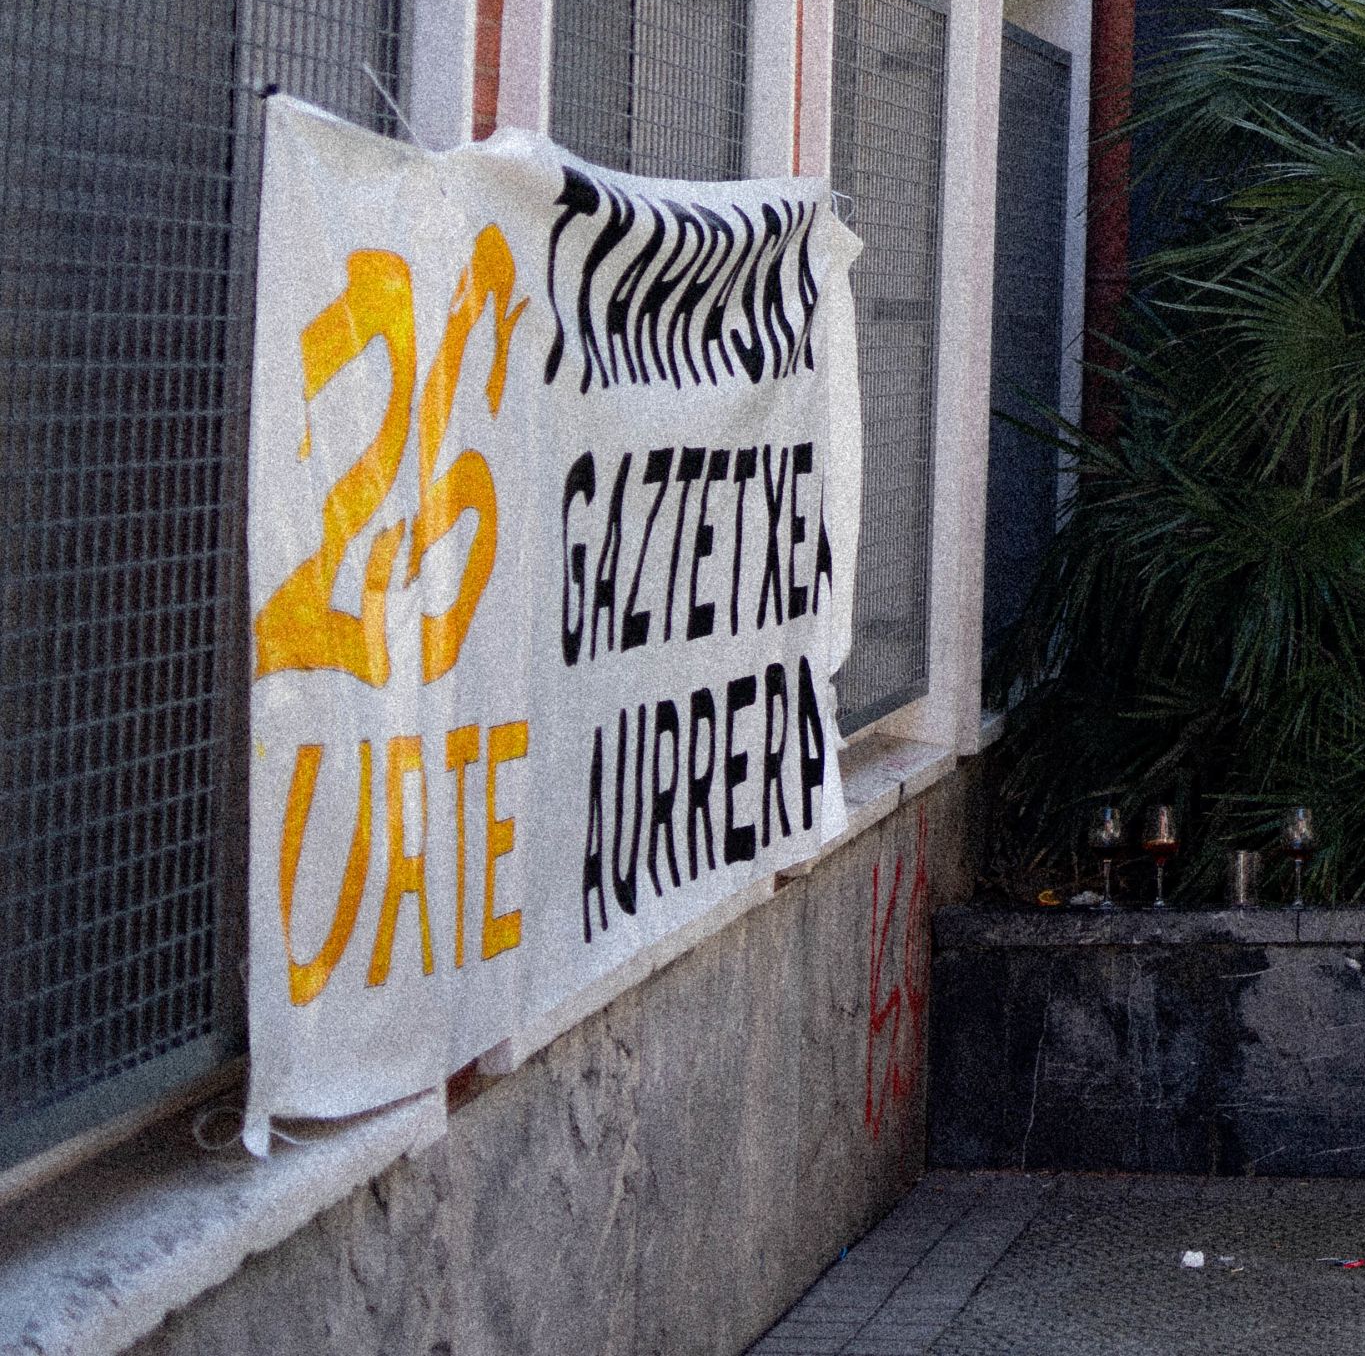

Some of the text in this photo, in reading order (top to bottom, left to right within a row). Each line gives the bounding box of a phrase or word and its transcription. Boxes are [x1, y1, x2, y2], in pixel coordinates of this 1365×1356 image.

[543, 165, 819, 394] TXARRASKA
[561, 441, 834, 667] GAZTETXEA
[581, 654, 826, 944] AURRERA
